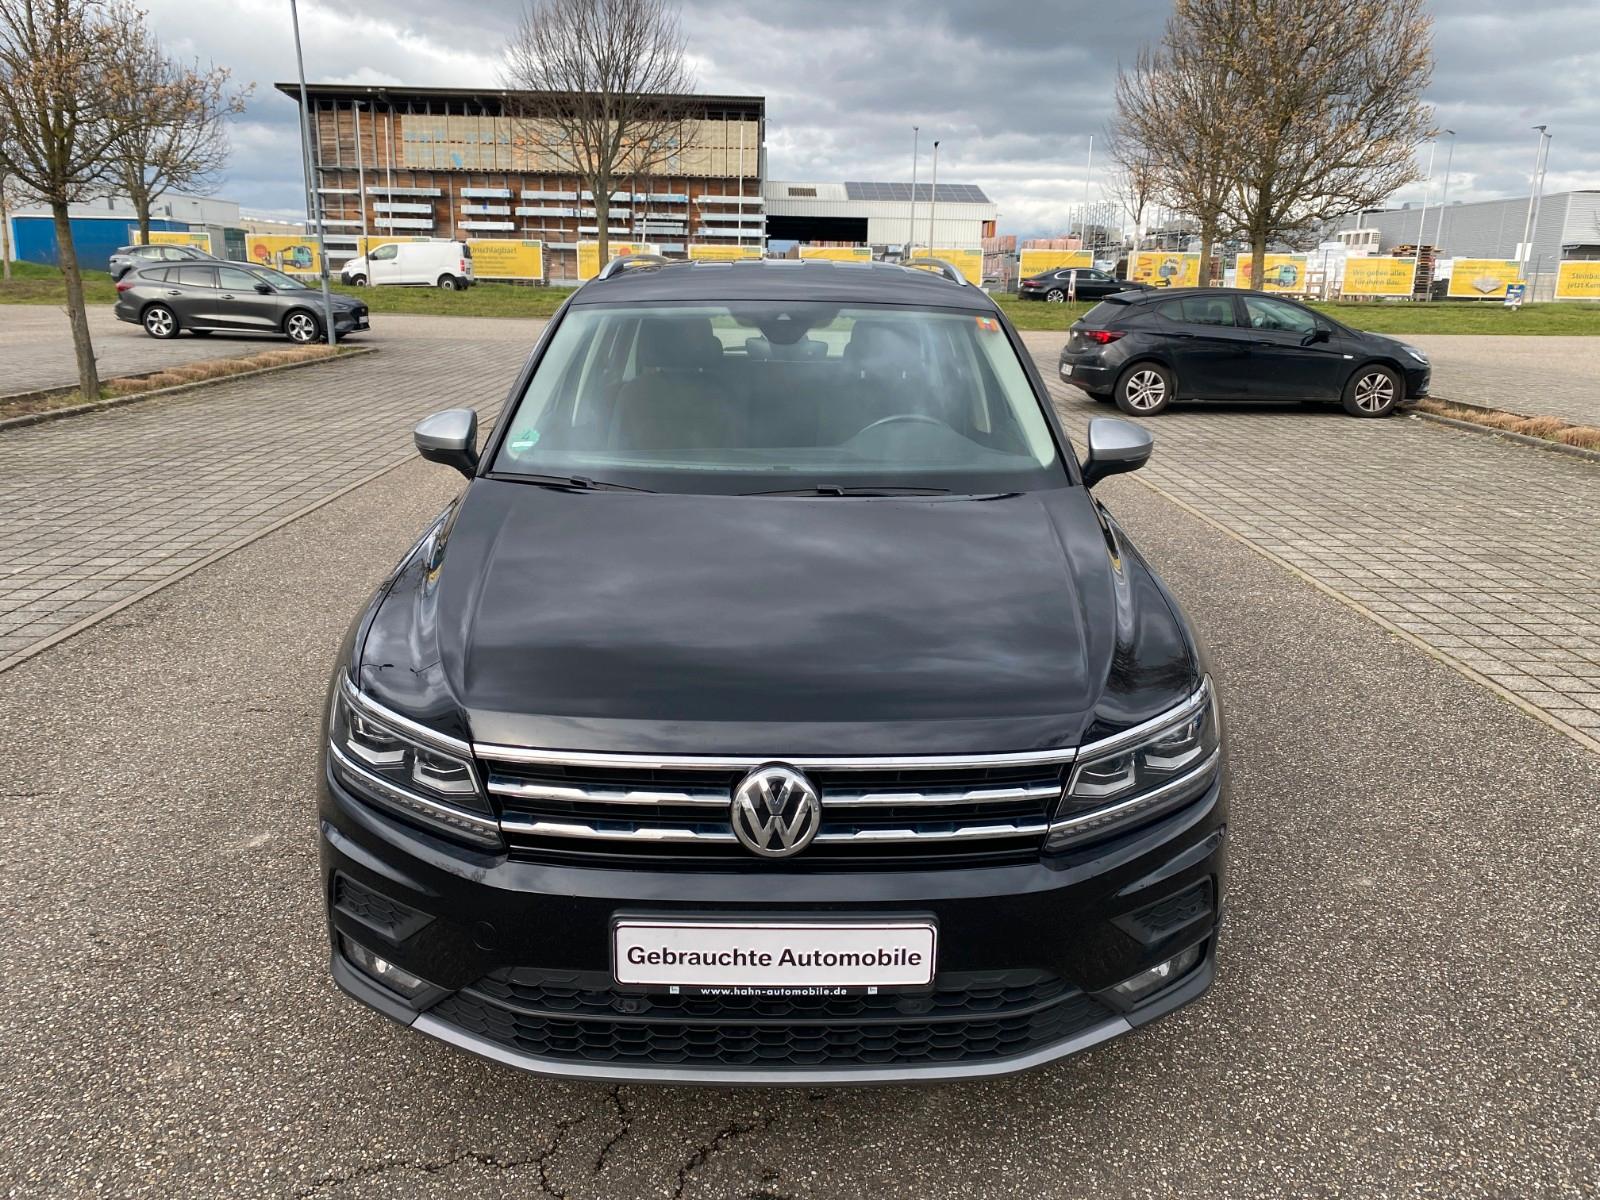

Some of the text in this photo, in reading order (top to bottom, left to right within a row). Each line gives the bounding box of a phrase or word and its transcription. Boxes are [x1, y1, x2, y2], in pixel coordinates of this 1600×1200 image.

[626, 945, 922, 968] Gebrauchte Automobile
[700, 985, 847, 997] www.hahn-automobile.de
